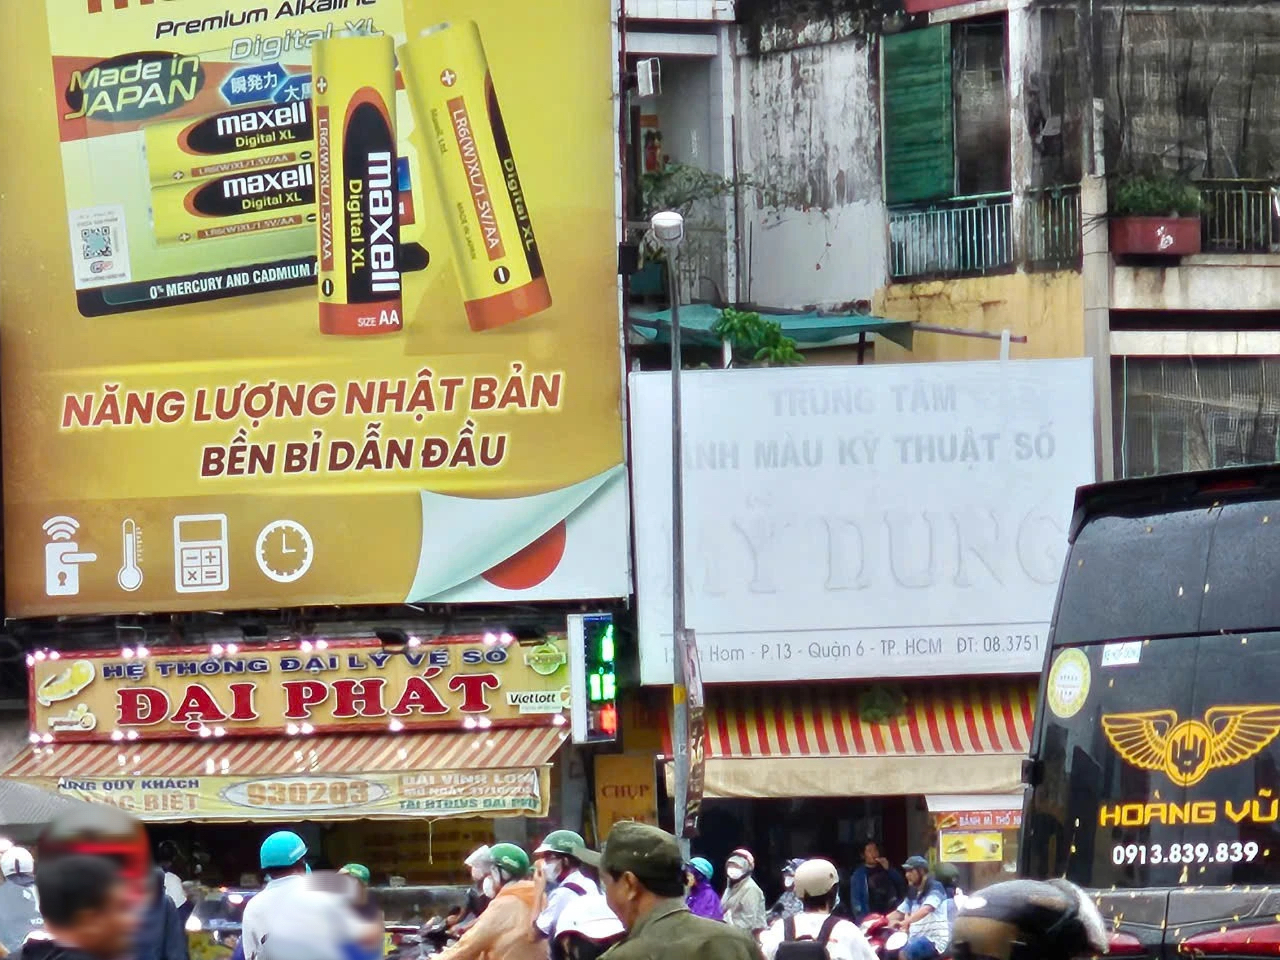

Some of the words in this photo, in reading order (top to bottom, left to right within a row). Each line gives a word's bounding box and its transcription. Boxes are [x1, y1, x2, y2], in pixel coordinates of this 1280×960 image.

[155, 9, 268, 39] Premium
[69, 58, 161, 91] Made
[169, 53, 200, 77] in
[63, 76, 198, 120] JAPAN
[217, 101, 307, 136] maxell
[236, 131, 276, 148] Digital
[278, 129, 296, 141] XL
[223, 164, 313, 198] maxell
[241, 194, 283, 210] Digital
[285, 192, 302, 203] XL
[346, 178, 365, 243] Digital
[503, 158, 530, 221] Digital
[522, 224, 537, 252] XL
[368, 151, 401, 292] maxell
[350, 248, 365, 273] XL
[166, 276, 223, 298] MERCURY
[226, 271, 250, 288] AND
[252, 263, 310, 283] CADMIUM
[357, 316, 376, 328] SIZE
[378, 309, 400, 325] AA
[62, 382, 185, 429] NĂNG
[193, 380, 337, 433] LƯỢNG
[344, 367, 464, 423] NHẬT
[470, 362, 562, 411] BẢN
[200, 426, 276, 478] BỀN
[283, 427, 321, 472] BỈ
[328, 421, 413, 471] DẪN
[421, 418, 507, 467] ĐẦU
[710, 645, 745, 662] Hom
[856, 640, 864, 656] 6
[880, 639, 900, 656] TP.
[905, 637, 942, 654] HCM
[983, 635, 1040, 652] 08.3751
[102, 661, 145, 680] HỆ
[157, 656, 268, 678] THỐNG
[280, 654, 339, 675] ĐẠI
[117, 682, 259, 732] ĐẠI
[280, 665, 501, 720] PHÁT
[1100, 790, 1216, 827] HOÀNG
[1225, 789, 1279, 824] VŨ
[1112, 841, 1259, 866] 0913.839.839
